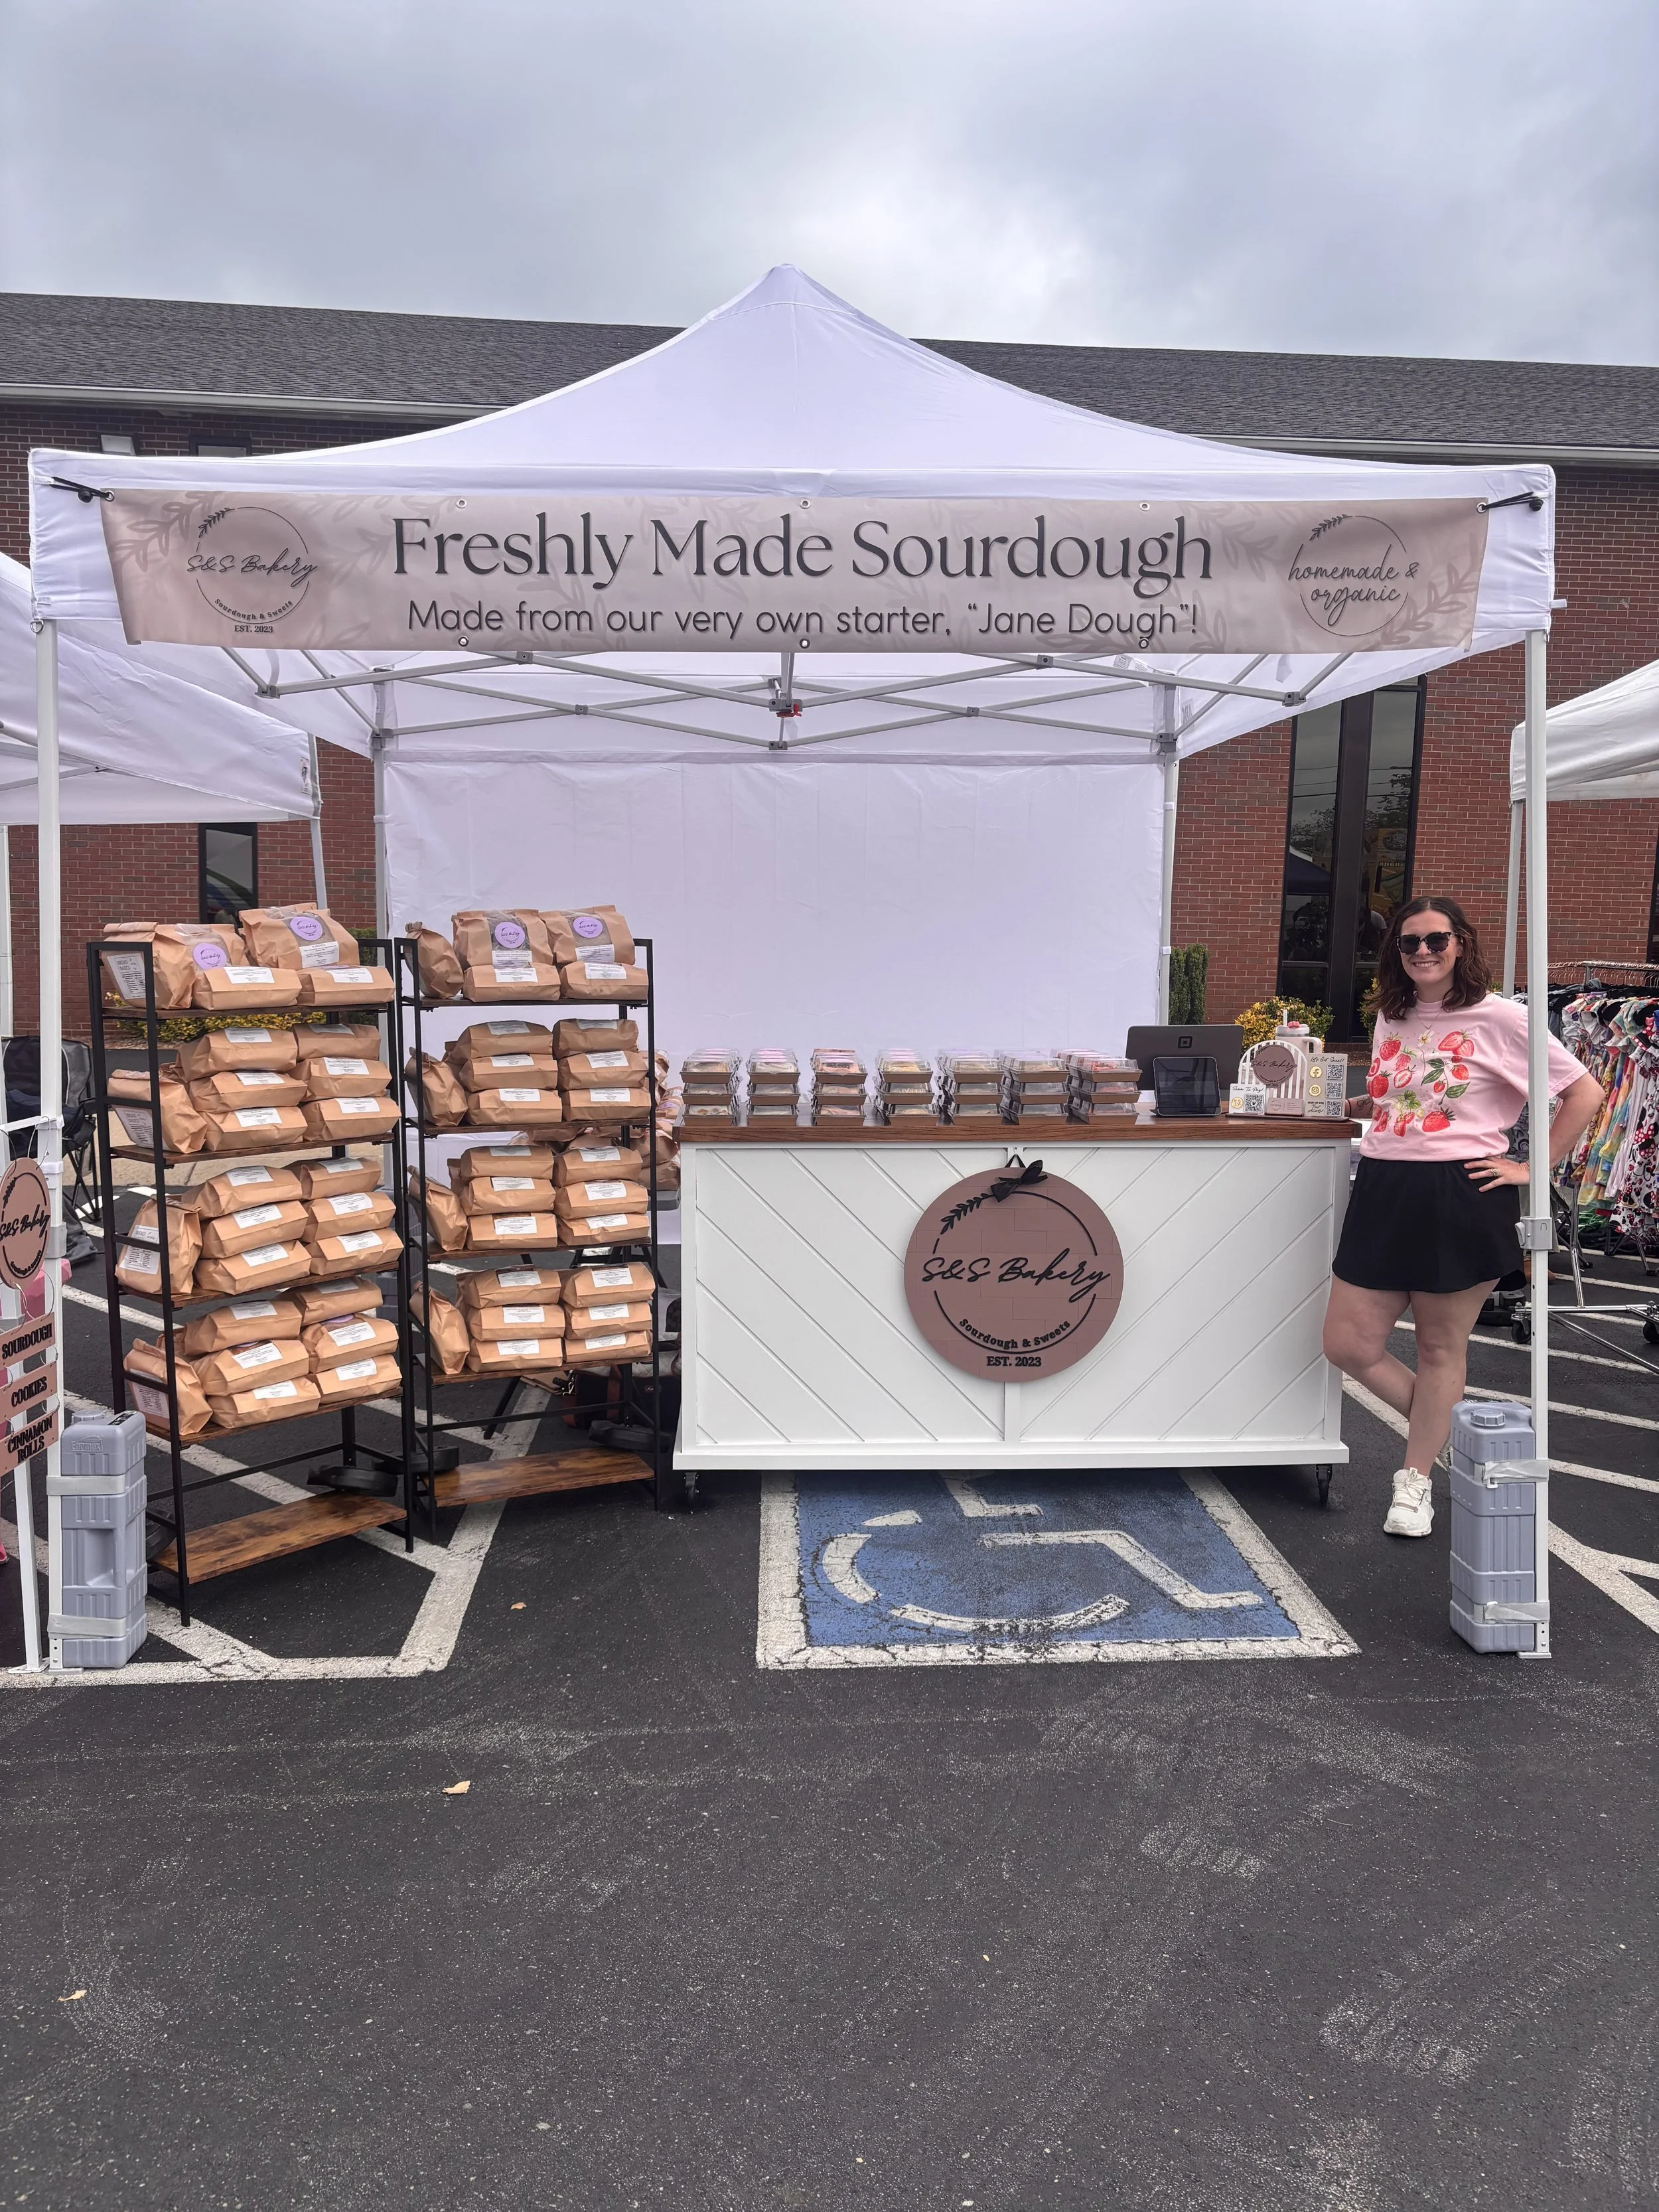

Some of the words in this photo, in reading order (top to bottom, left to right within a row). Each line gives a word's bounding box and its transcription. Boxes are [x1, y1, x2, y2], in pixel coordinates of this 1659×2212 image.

[186, 555, 236, 574] S&S
[240, 548, 318, 588] Bakery
[393, 512, 633, 589] Freshly
[650, 514, 833, 577] Made
[852, 515, 1212, 598] Sourdough
[1288, 544, 1399, 581] homemade
[1404, 561, 1417, 579] &
[214, 598, 256, 621] Sourdough
[267, 599, 293, 619] Sweets
[408, 600, 502, 631] Made
[516, 601, 593, 632] from
[607, 611, 662, 632] our
[676, 611, 743, 640] very
[756, 612, 824, 632] own
[837, 605, 950, 636] starter,
[1311, 585, 1401, 627] organic
[254, 625, 273, 634] 2023
[1269, 1059, 1297, 1072] Bakery
[20, 1204, 50, 1238] Bakery
[922, 1257, 990, 1282] S&S
[998, 1248, 1111, 1303] Bakery
[2, 1323, 52, 1359] SOURDOUGH
[960, 1319, 1018, 1349] Sourdough
[1022, 1339, 1031, 1347] &
[1034, 1320, 1070, 1345] Sweets
[986, 1356, 1012, 1366] EST.
[1015, 1356, 1042, 1367] 2023
[11, 1376, 47, 1408] COOKIES
[7, 1416, 52, 1453] CINNAMON
[17, 1436, 44, 1464] ROLLS
